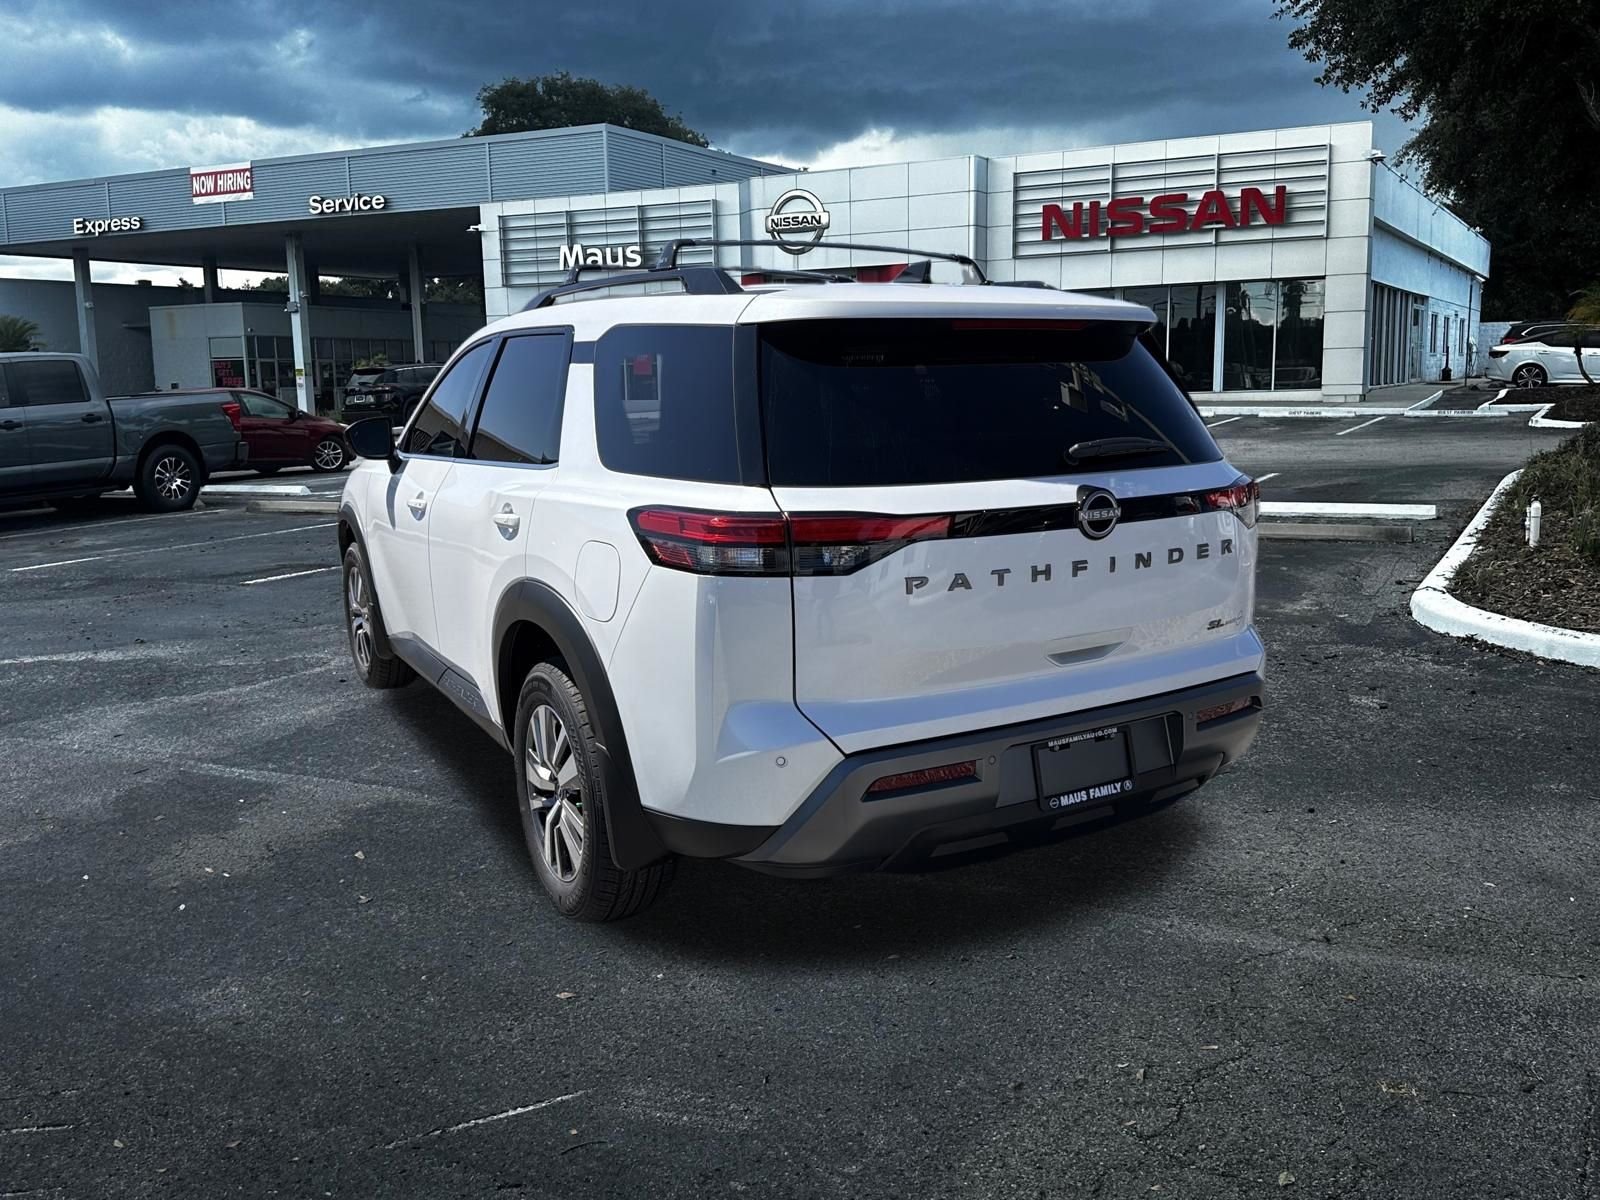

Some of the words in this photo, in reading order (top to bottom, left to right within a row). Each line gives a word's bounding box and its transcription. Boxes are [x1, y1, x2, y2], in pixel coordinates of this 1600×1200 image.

[192, 174, 215, 195] NOW
[217, 171, 251, 192] HIRING
[309, 193, 385, 214] Service
[1041, 185, 1287, 241] NISSAN
[73, 216, 141, 236] Express
[770, 215, 822, 228] NISSAN
[559, 243, 642, 270] Maus
[1080, 508, 1121, 520] NISSAN
[904, 539, 1233, 595] PATHFINDER
[1207, 618, 1225, 630] SL
[1048, 727, 1118, 747] MAUSFAMILYAUTO.COM
[1060, 790, 1088, 807] MAUS
[1089, 782, 1122, 799] FAMILY
